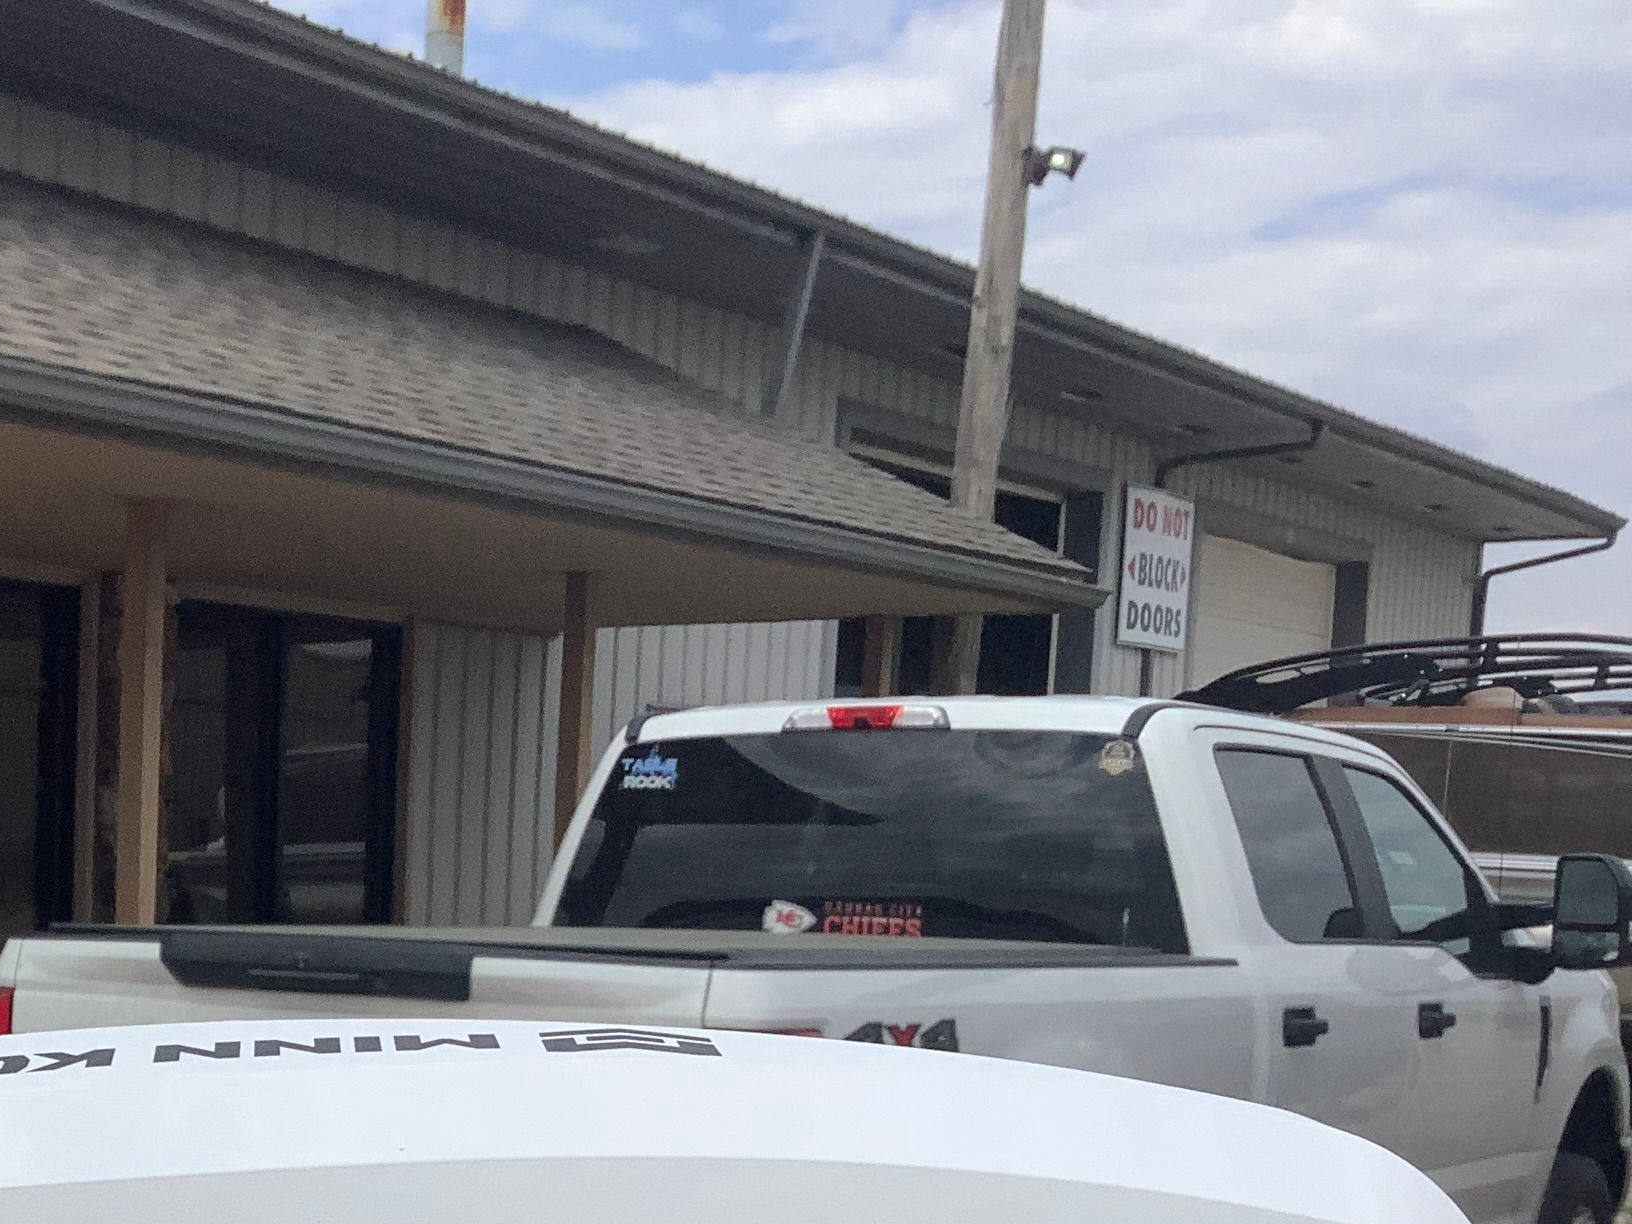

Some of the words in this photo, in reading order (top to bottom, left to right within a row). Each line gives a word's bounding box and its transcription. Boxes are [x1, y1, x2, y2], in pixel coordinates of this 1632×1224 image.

[1134, 498, 1158, 532] DO
[1163, 505, 1189, 540] NOT
[1138, 552, 1180, 592] BLOCK
[1126, 600, 1181, 638] DOORS
[823, 915, 922, 936] CHIEFS
[153, 1034, 500, 1063] MINN
